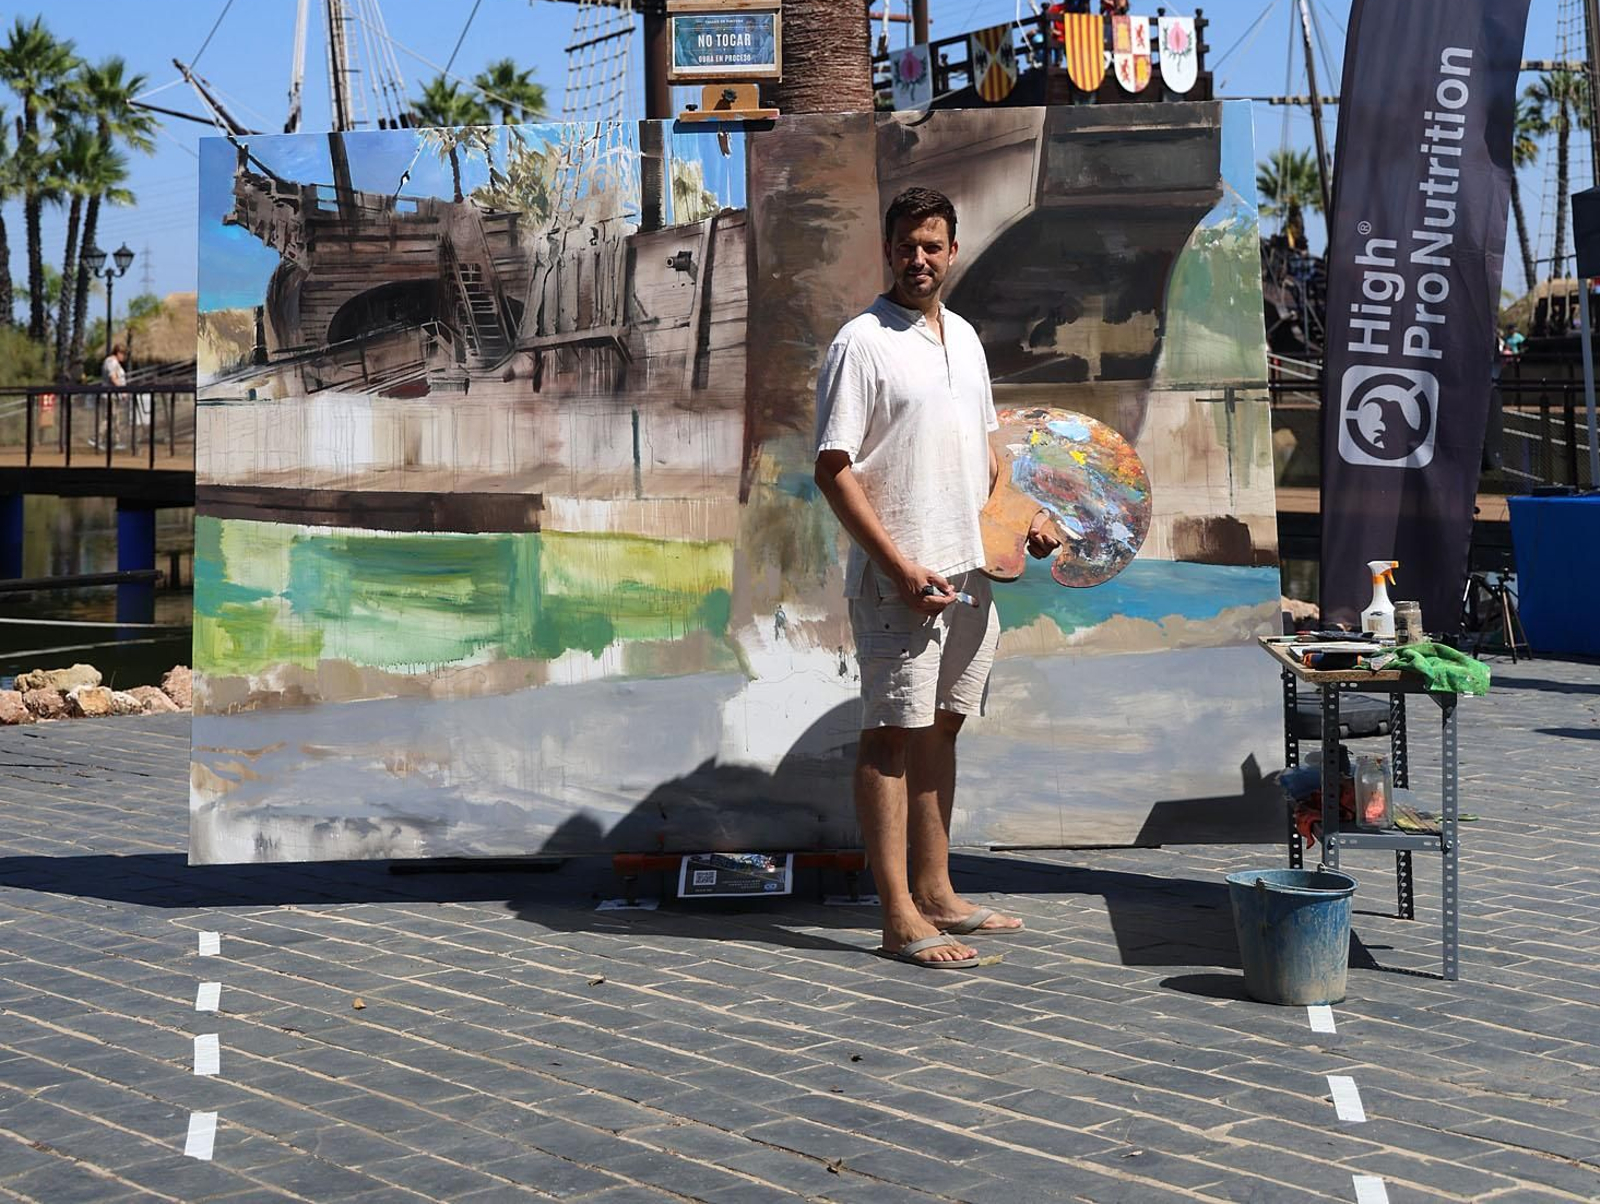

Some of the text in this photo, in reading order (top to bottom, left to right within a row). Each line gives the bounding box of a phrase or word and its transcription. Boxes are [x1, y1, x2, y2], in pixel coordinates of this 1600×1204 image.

[698, 33, 751, 47] NO TOCAR
[715, 55, 724, 63] EN
[725, 54, 751, 62] PROCESO
[1402, 45, 1474, 360] ProNutrition
